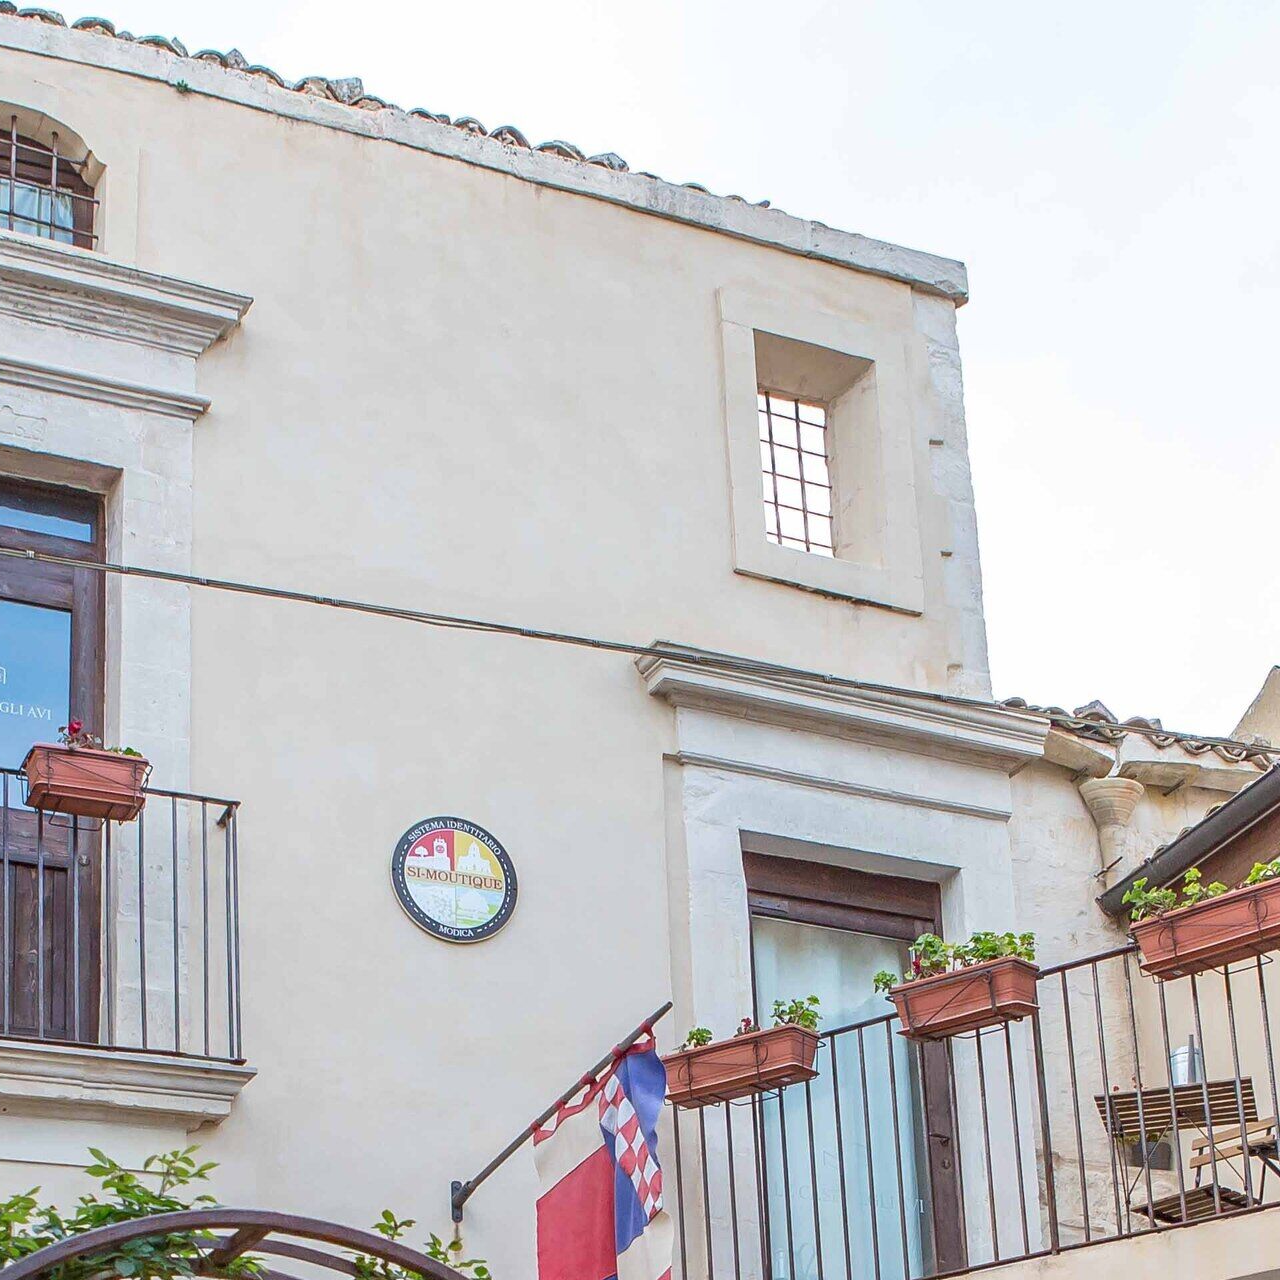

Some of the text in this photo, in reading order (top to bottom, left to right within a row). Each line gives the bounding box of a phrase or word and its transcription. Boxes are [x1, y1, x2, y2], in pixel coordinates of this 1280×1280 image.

[27, 705, 52, 721] AVI
[407, 820, 502, 856] SISTEMA IDENTITARIO
[407, 866, 502, 890] SI-MOUTIQUE
[438, 925, 475, 937] MODICA
